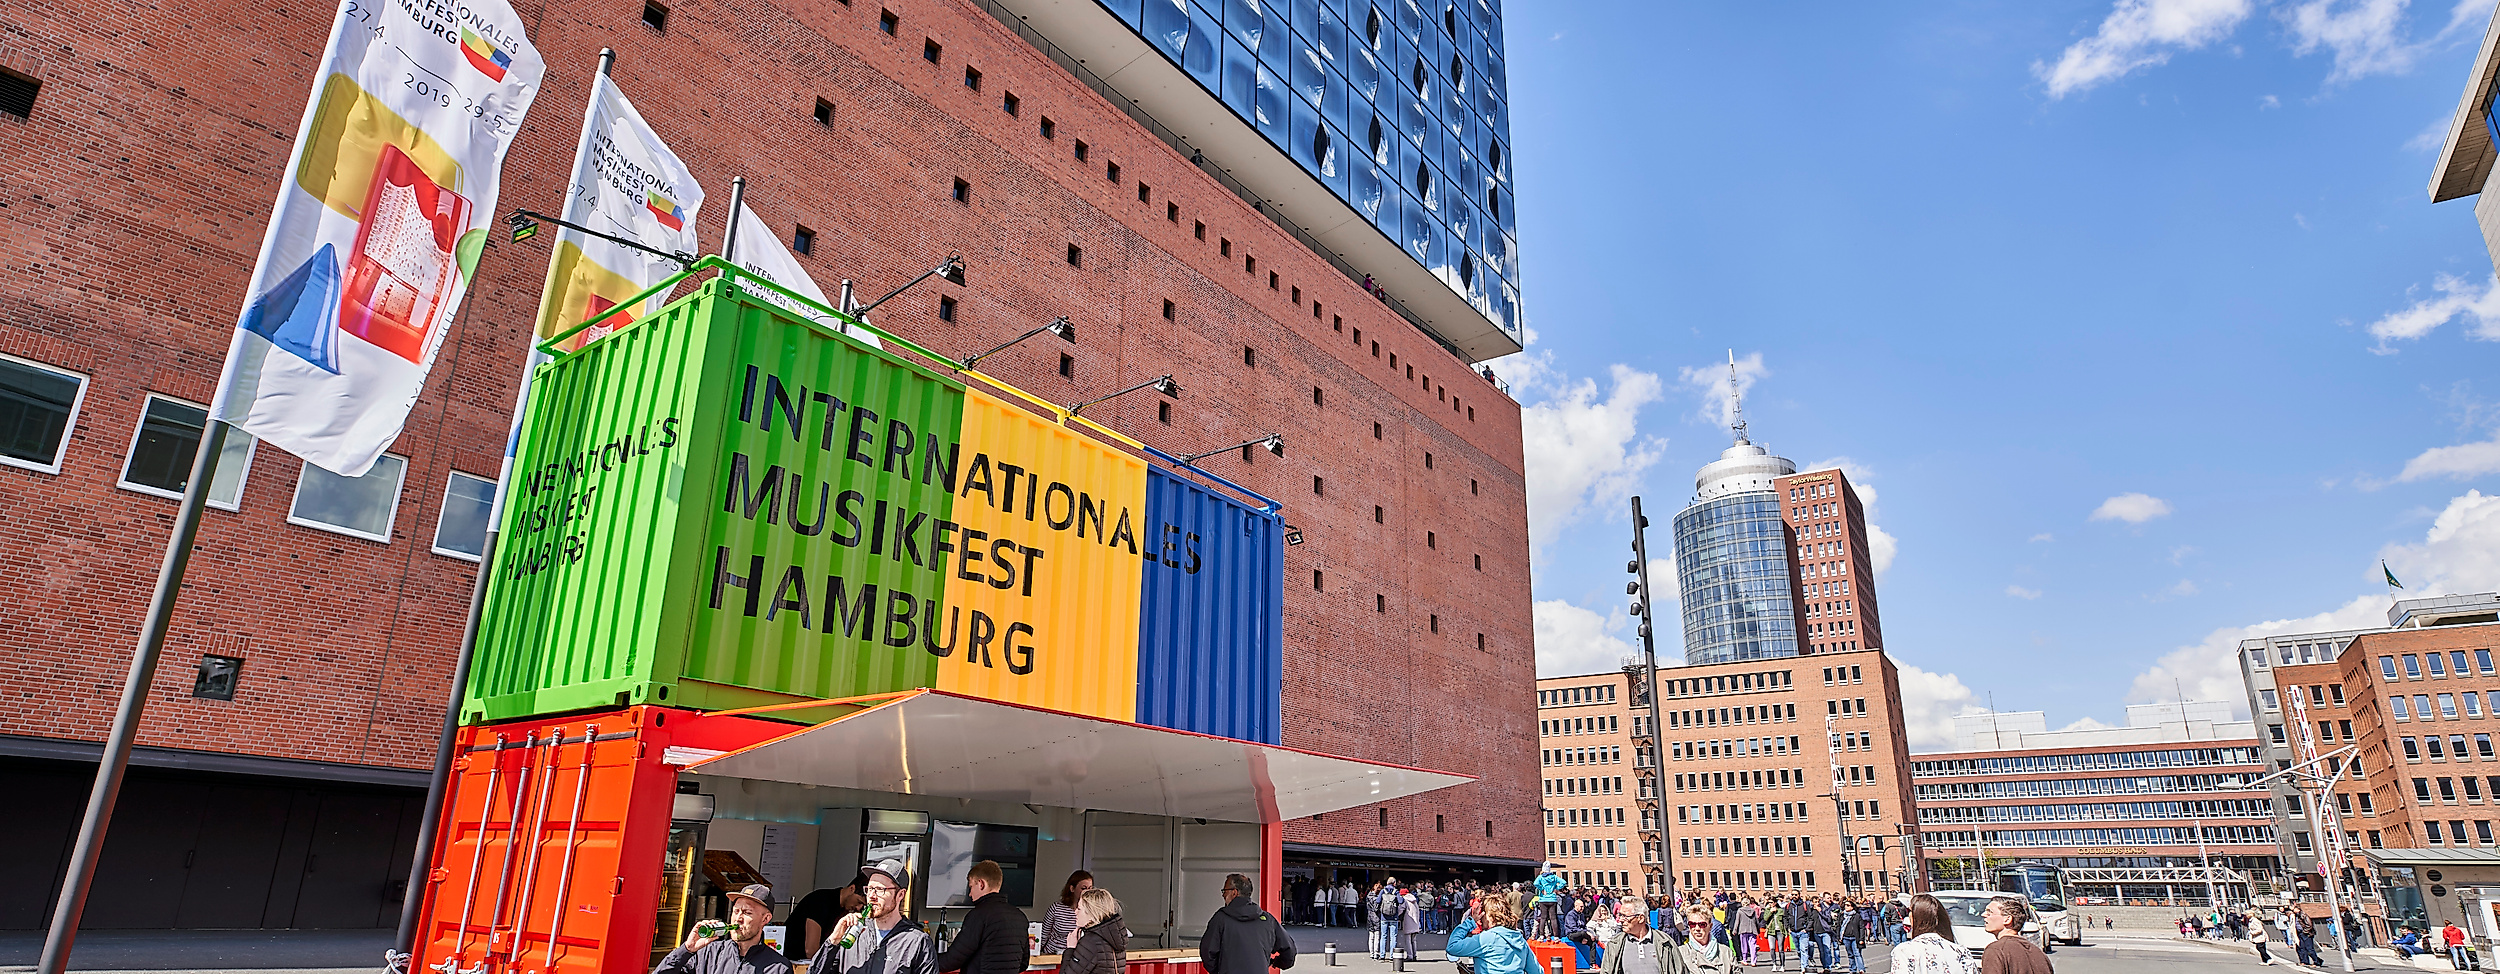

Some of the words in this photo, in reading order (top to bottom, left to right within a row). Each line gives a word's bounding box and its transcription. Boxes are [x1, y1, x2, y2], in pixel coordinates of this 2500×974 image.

[404, 72, 450, 108] 2019
[723, 451, 1043, 597] MUSIKFEST
[739, 363, 1201, 575] INTERNATIONALES
[708, 546, 1036, 676] HAMBURG
[2077, 847, 2123, 855] COLUMBUS
[2124, 846, 2148, 855] HAUS
